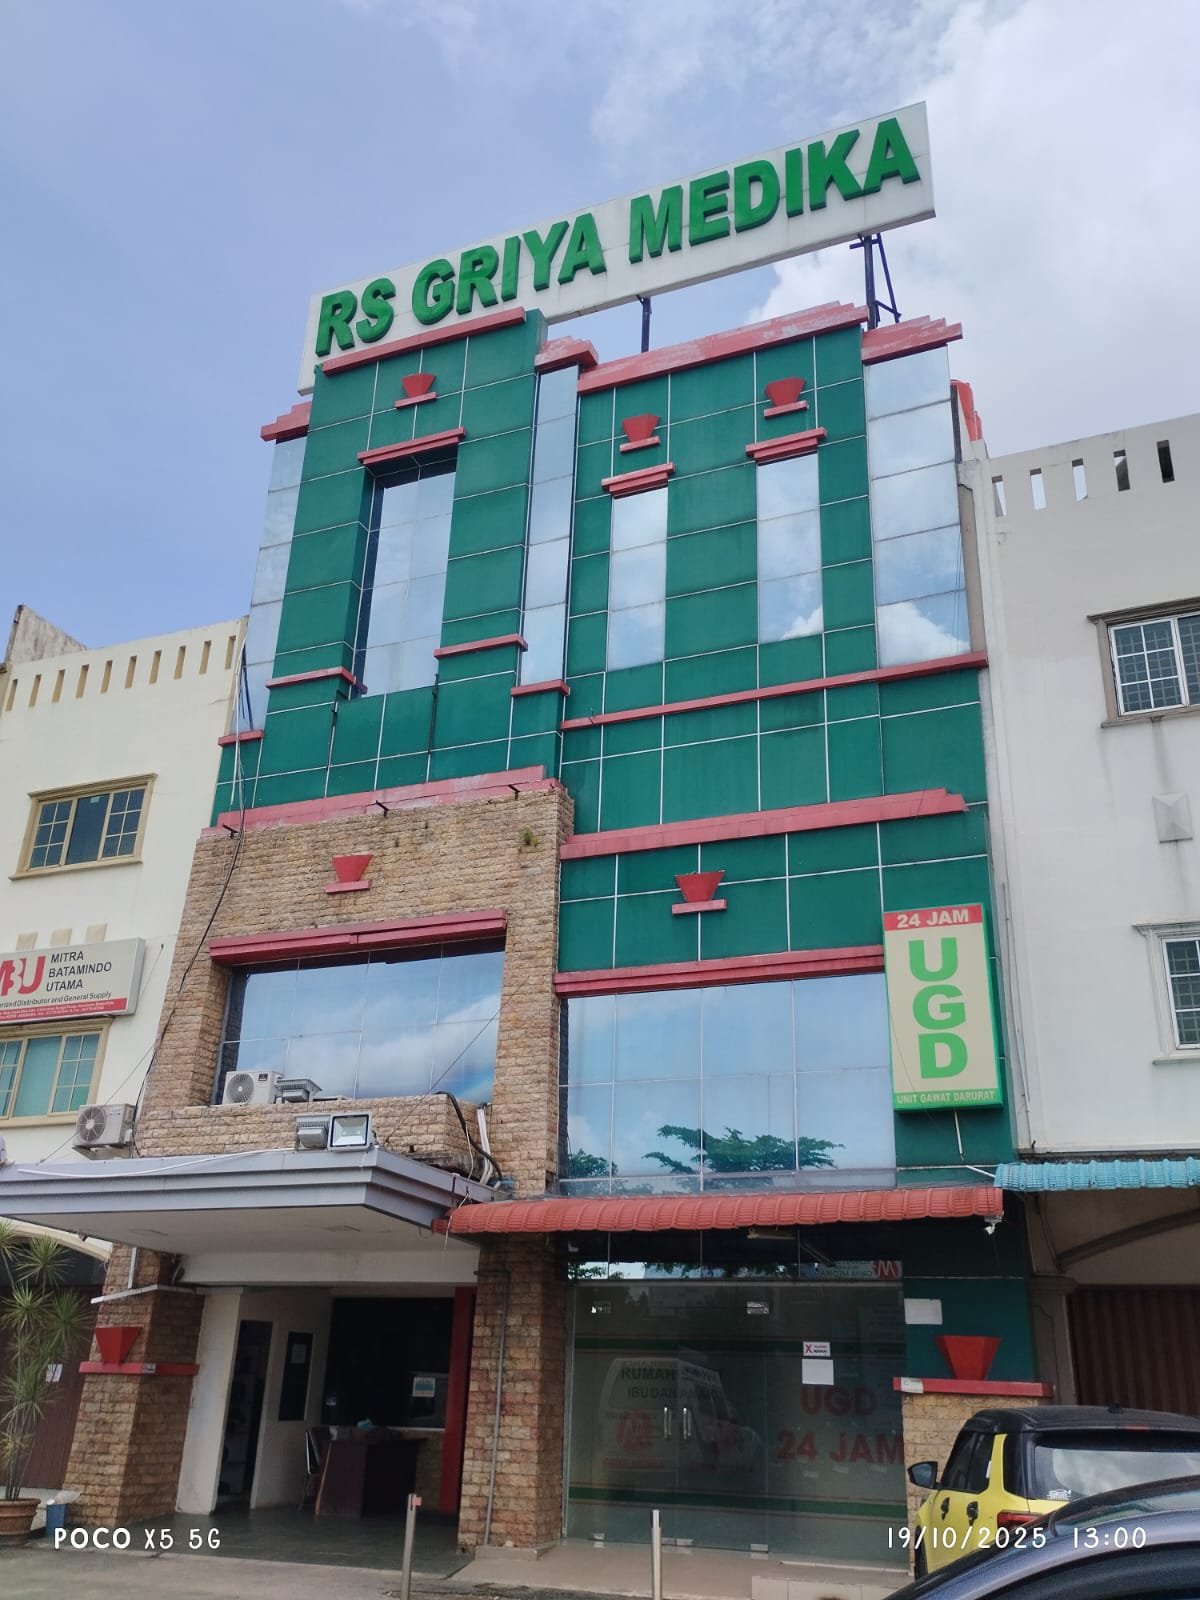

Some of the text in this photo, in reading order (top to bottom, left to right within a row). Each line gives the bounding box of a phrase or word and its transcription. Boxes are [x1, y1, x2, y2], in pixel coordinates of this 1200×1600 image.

[314, 117, 921, 357] RS GRIYA MEDIKA
[896, 908, 969, 928] 24 JAM
[50, 950, 84, 963] MITRA
[48, 961, 112, 978] BATAMINDO
[46, 979, 84, 992] UTAMA
[64, 994, 88, 1002] General
[89, 991, 112, 1000] Supply
[908, 936, 969, 1079] UGD
[896, 1090, 995, 1104] UNIT GAWAT DARURAT
[621, 1366, 675, 1380] RUMAH
[627, 1386, 648, 1398] IBU
[651, 1387, 677, 1399] DAN
[801, 1385, 878, 1416] UGD
[776, 1430, 904, 1464] 24 JAM
